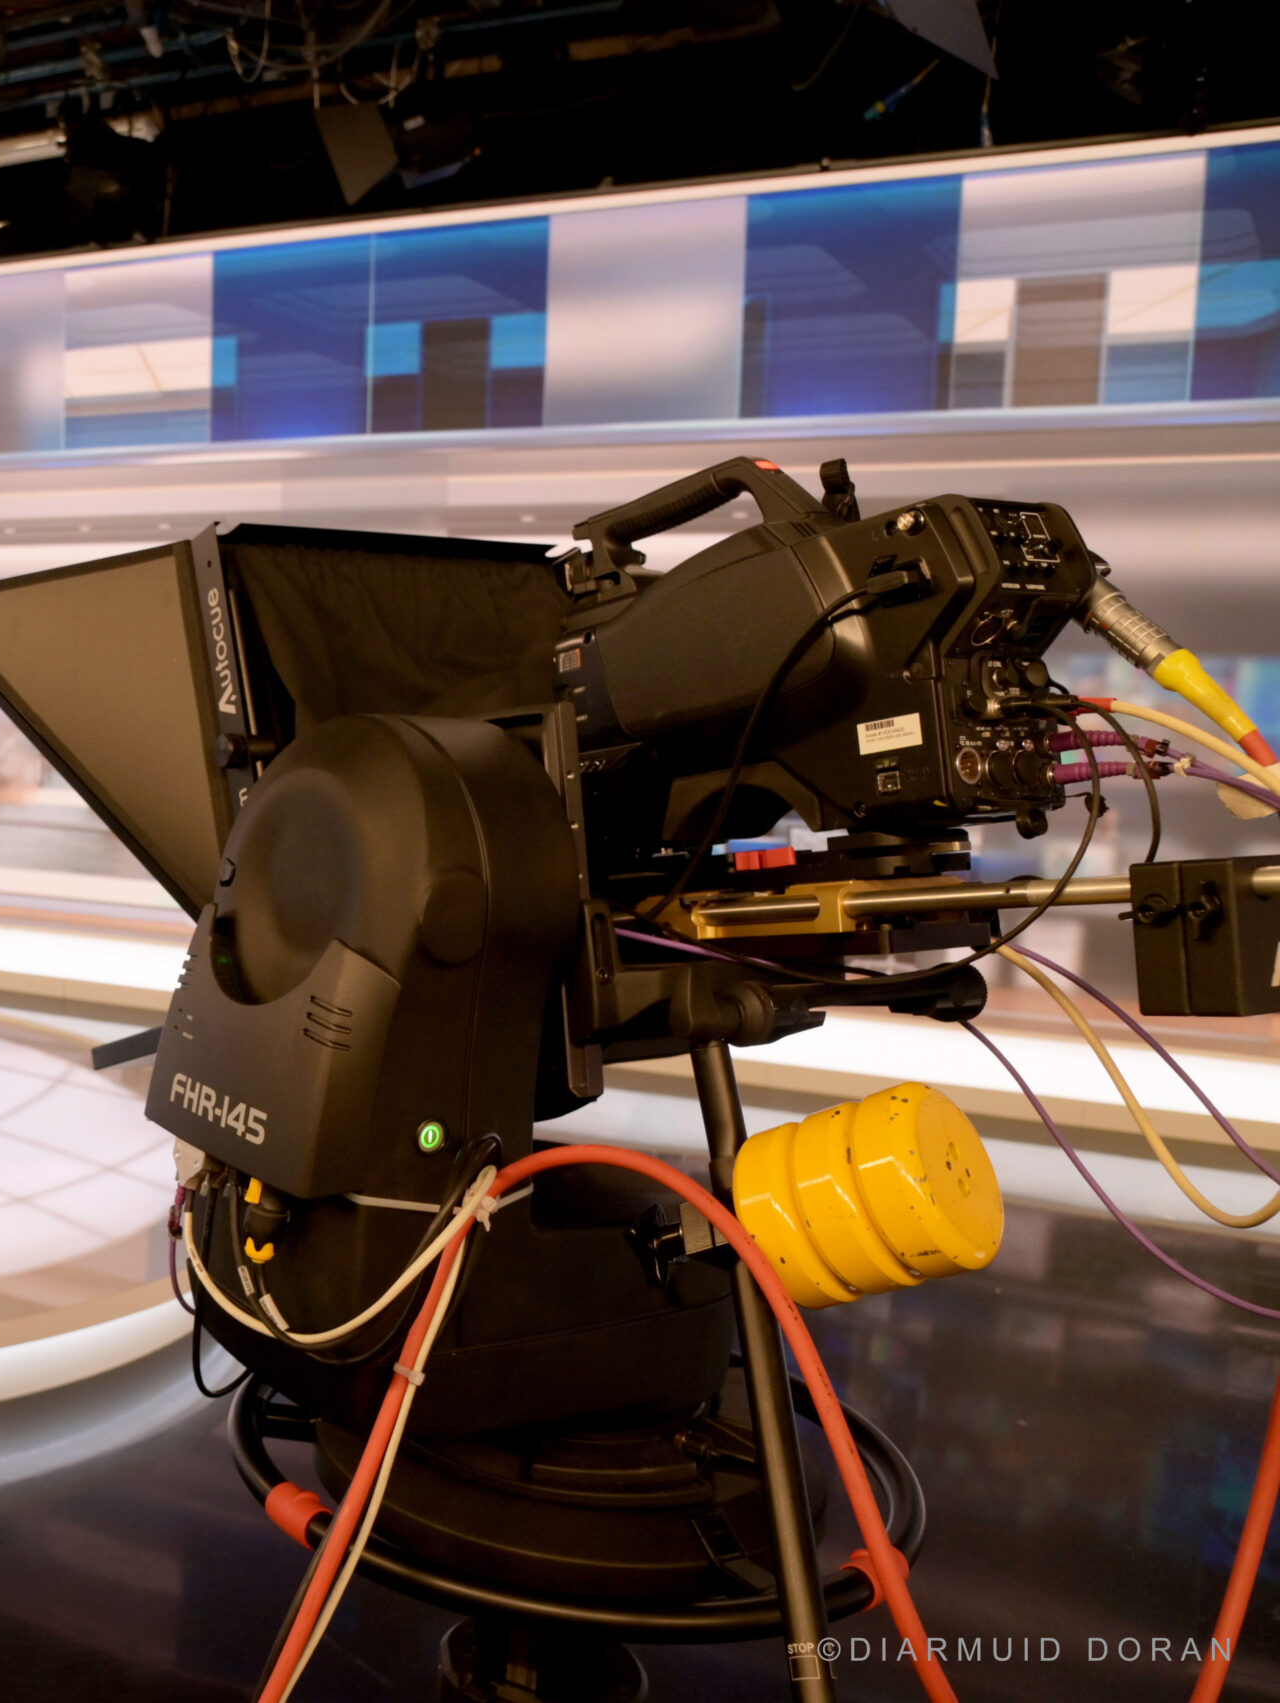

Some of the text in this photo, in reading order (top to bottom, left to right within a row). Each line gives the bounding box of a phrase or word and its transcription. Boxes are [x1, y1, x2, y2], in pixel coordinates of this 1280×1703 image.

[207, 587, 237, 715] Autocue
[170, 1072, 268, 1145] FHR-145
[787, 1642, 815, 1655] STOP
